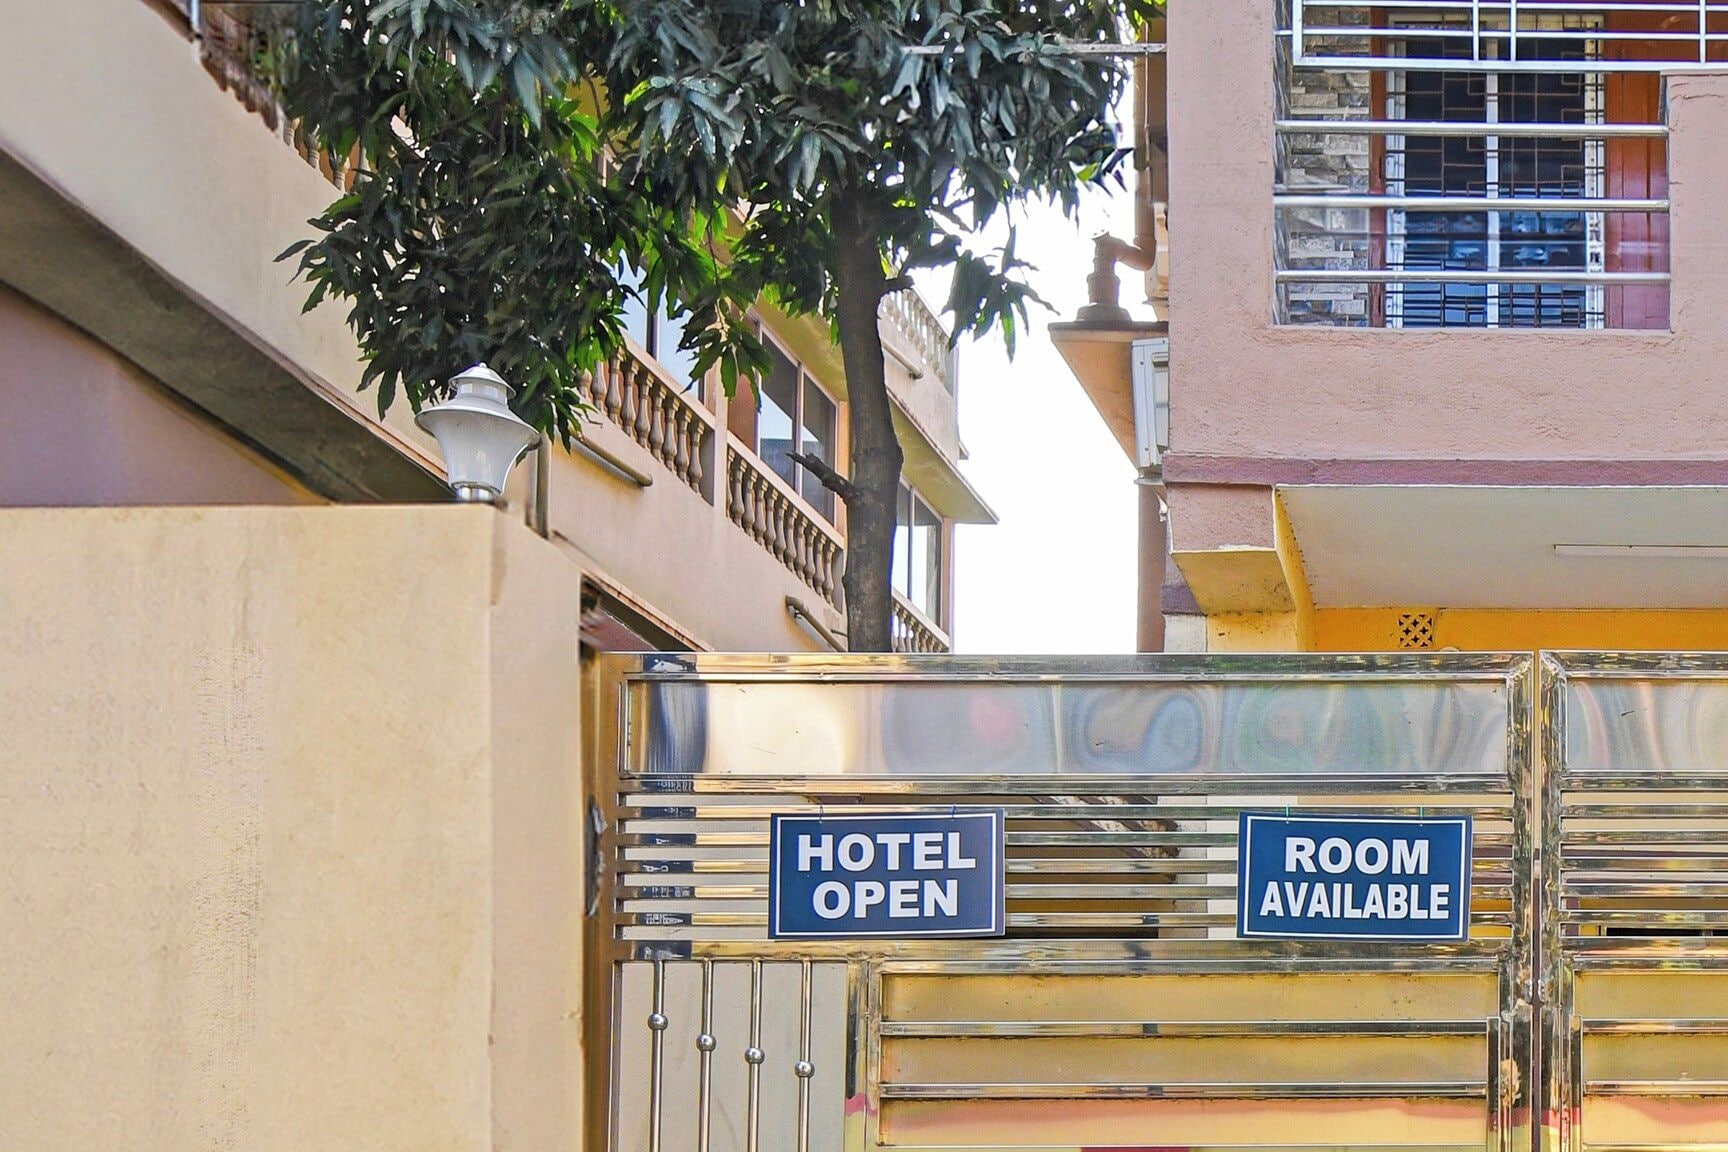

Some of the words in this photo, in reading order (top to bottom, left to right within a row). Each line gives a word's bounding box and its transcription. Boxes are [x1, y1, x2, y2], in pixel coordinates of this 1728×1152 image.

[797, 831, 978, 872] HOTEL
[1284, 836, 1430, 876] ROOM
[812, 879, 960, 920] OPEN
[1258, 880, 1451, 920] AVAILABLE
